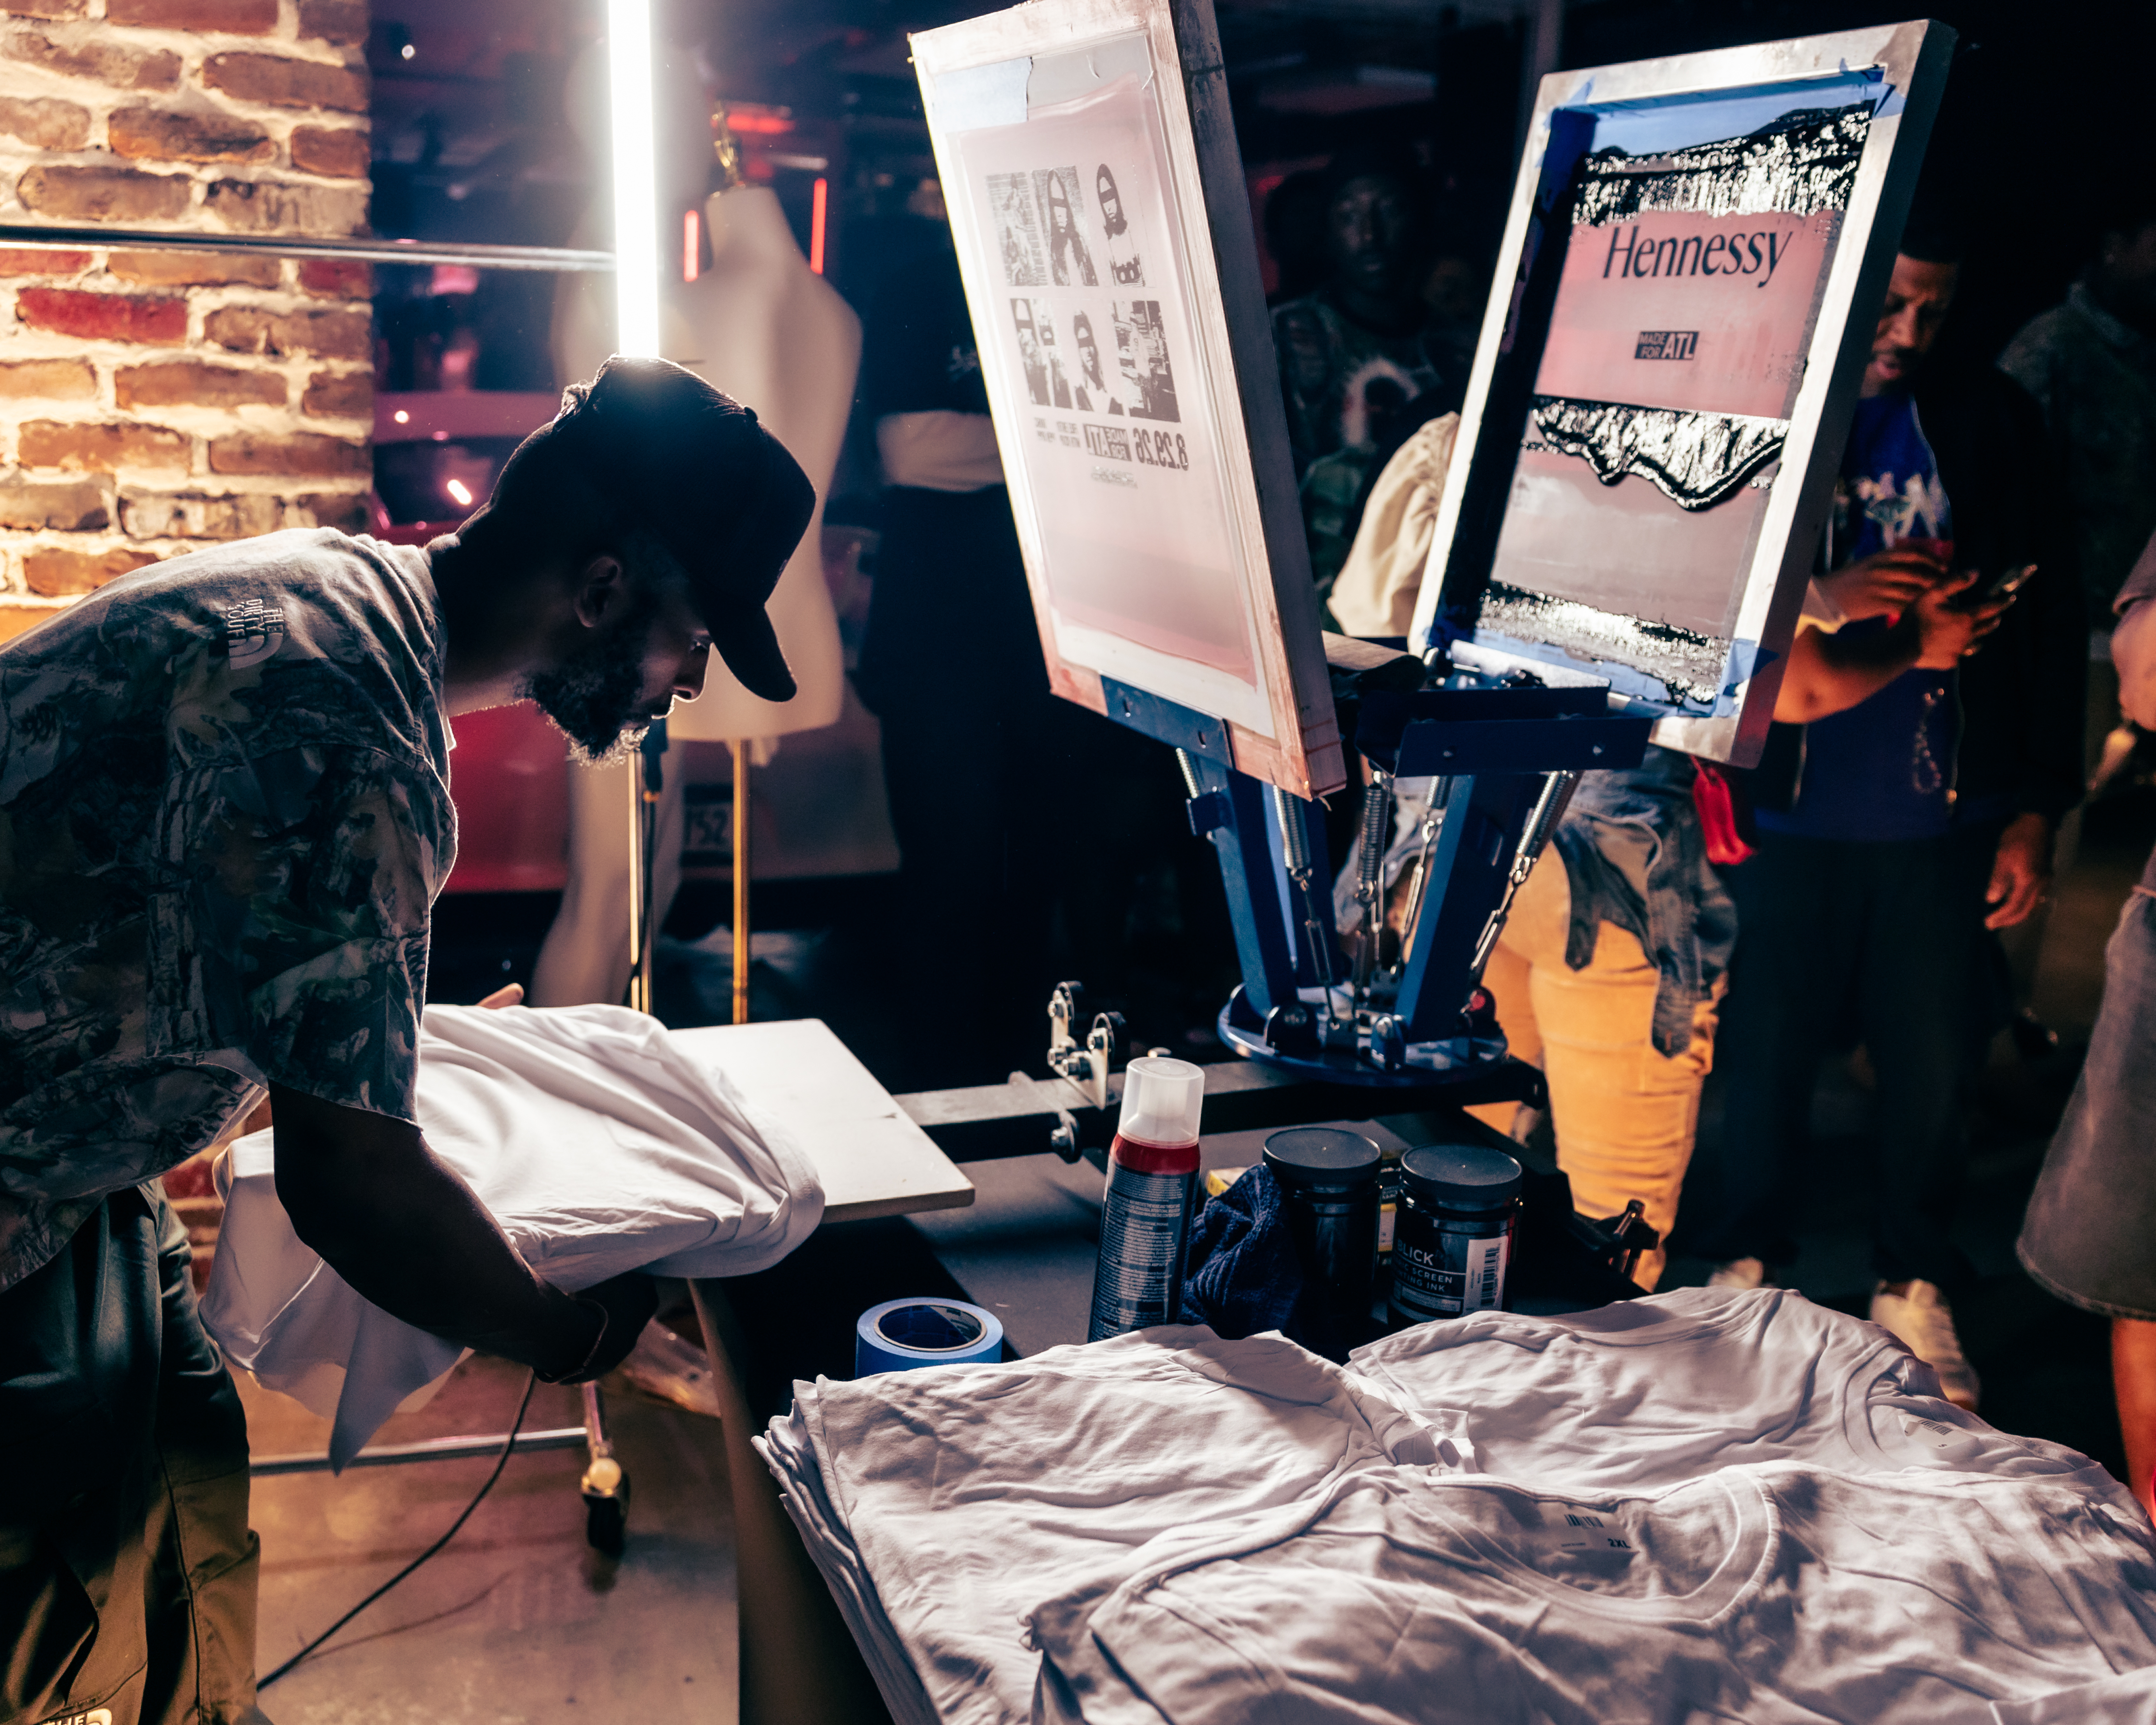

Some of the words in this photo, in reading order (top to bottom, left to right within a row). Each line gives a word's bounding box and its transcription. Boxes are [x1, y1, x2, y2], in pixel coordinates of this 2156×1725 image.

[1603, 225, 1793, 288] Hennessy
[1640, 332, 1667, 345] MADE
[1661, 332, 1694, 359] ATL
[1640, 346, 1661, 358] FOR
[243, 599, 265, 630] DIRTY
[263, 607, 284, 632] THE
[1397, 1238, 1434, 1266] BLICK
[1412, 1268, 1452, 1284] SCREEN
[1427, 1282, 1445, 1292] INK
[1607, 1538, 1632, 1553] 2XL
